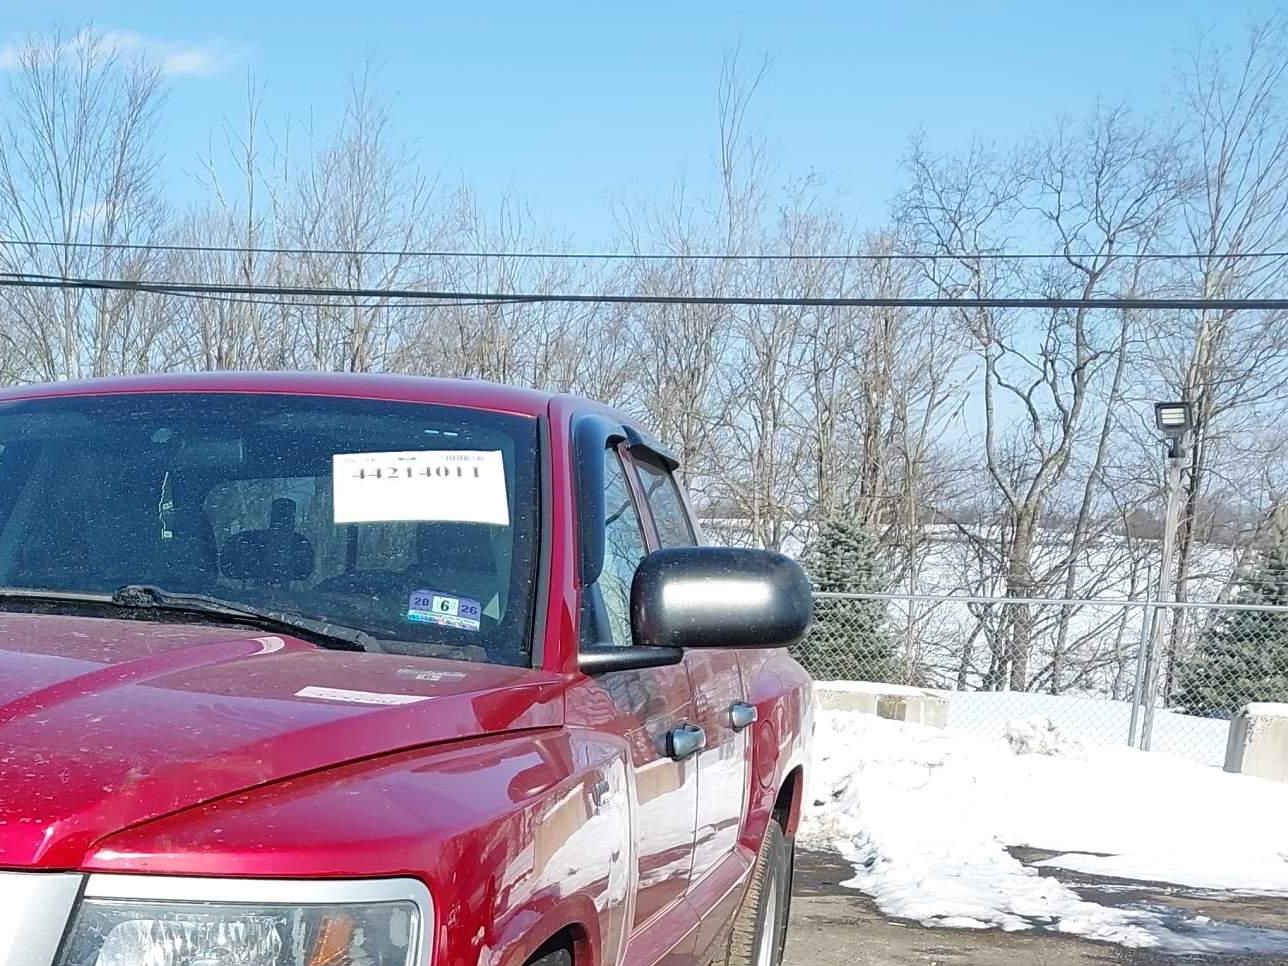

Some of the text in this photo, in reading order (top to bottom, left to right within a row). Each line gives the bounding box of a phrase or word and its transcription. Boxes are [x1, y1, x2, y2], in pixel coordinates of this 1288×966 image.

[352, 466, 480, 479] 44214011
[414, 597, 478, 615] 20 6 26
